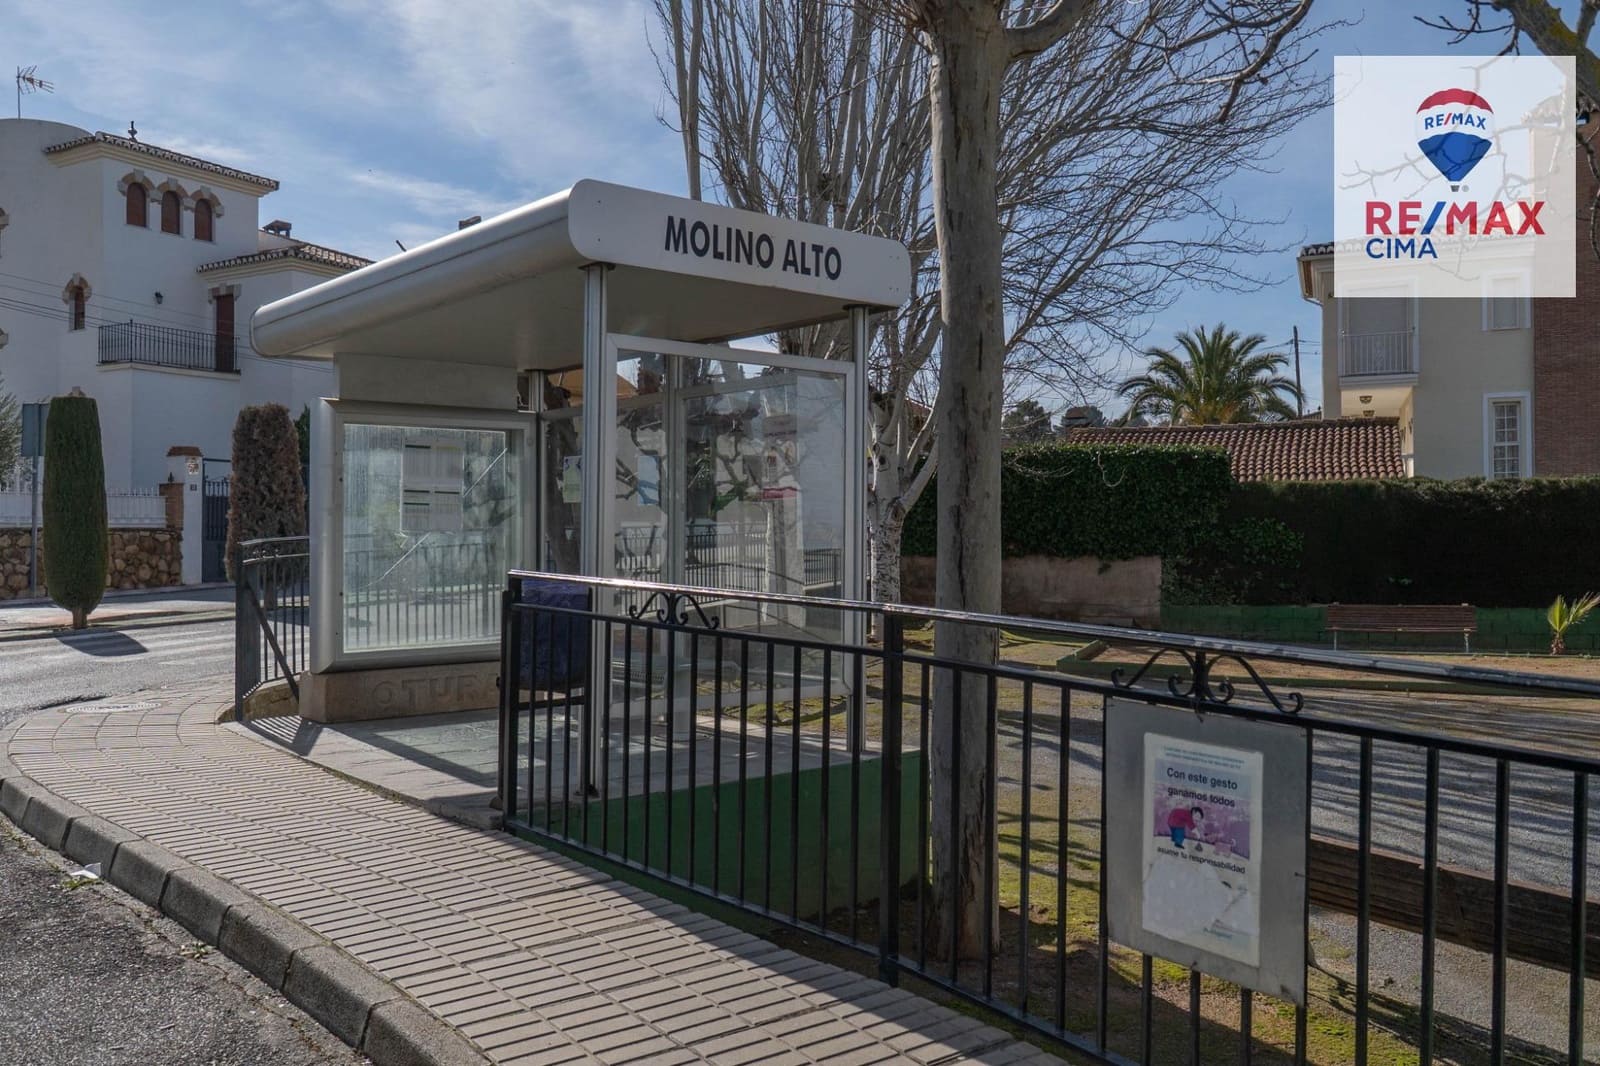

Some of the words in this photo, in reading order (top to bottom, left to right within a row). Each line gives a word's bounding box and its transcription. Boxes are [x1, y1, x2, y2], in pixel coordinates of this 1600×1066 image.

[664, 215, 775, 269] MOLINO
[782, 239, 842, 281] ALTO
[1166, 767, 1186, 780] Con
[1188, 773, 1208, 785] este
[1210, 778, 1238, 790] gesto
[1167, 786, 1208, 802] ganamos
[1209, 794, 1235, 807] todos
[1157, 846, 1180, 859] asume
[1188, 854, 1246, 875] responsabilidad
